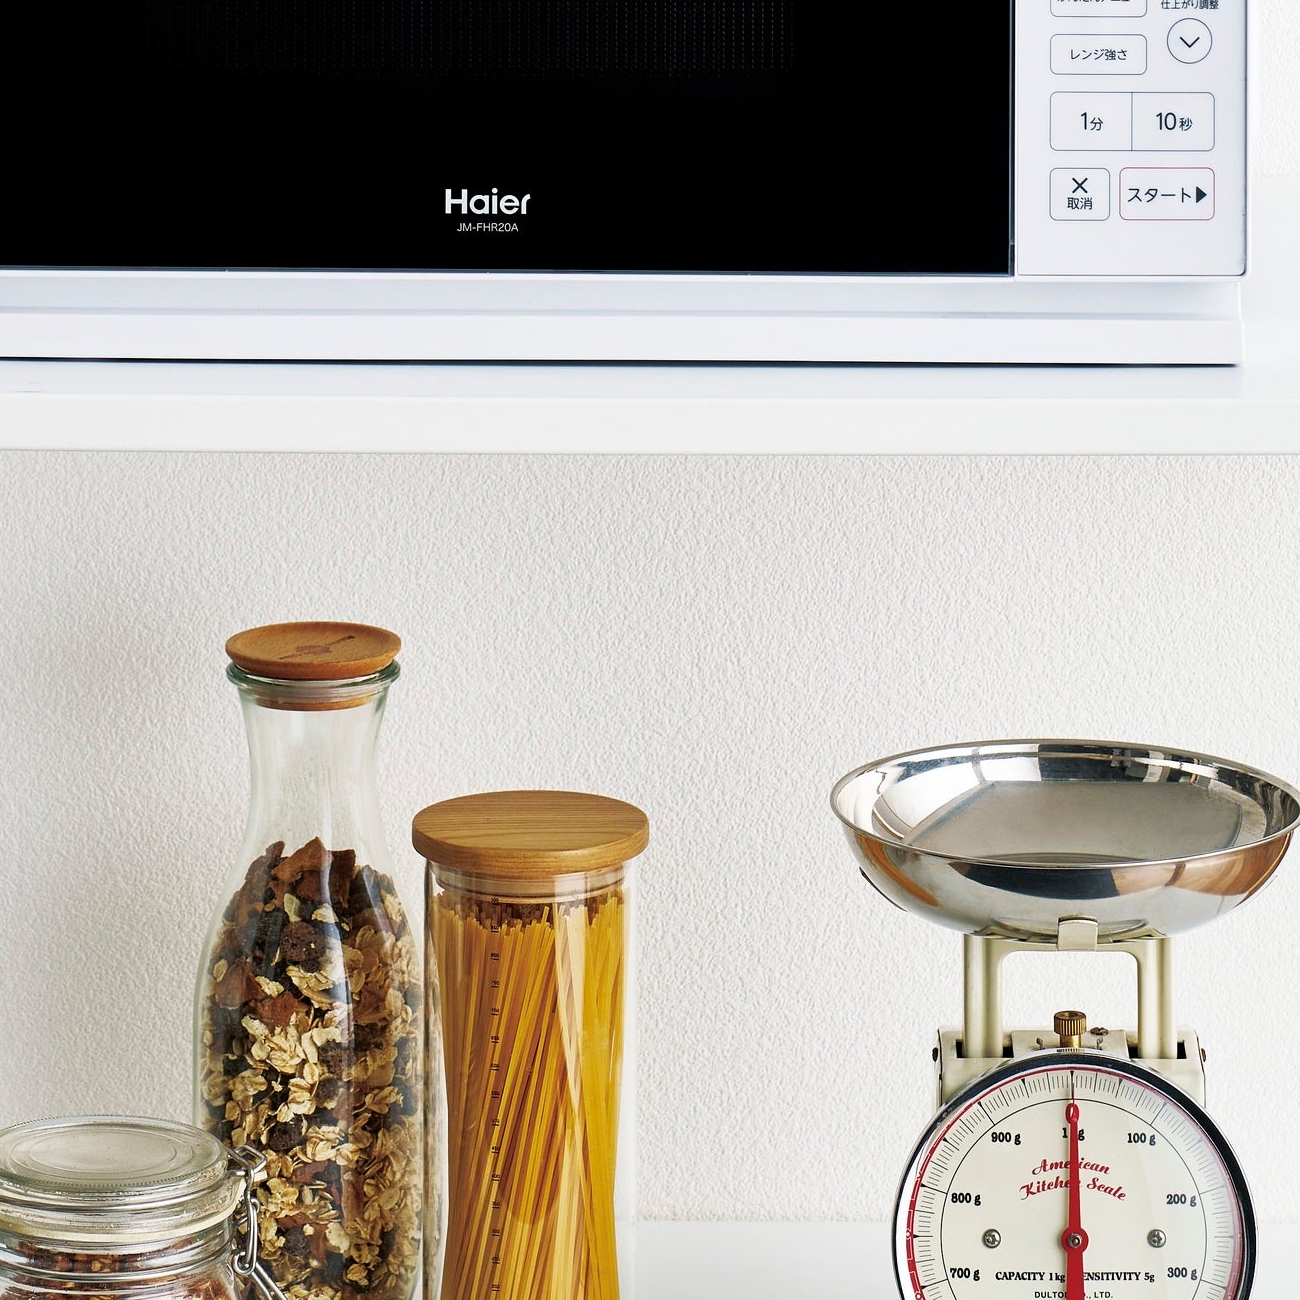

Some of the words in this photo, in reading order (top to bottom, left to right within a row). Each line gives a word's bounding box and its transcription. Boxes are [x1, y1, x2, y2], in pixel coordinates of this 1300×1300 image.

[1160, 0, 1220, 10] 仕上がり調整
[1070, 48, 1128, 61] レンジ強さ
[1080, 111, 1104, 132] 1分
[445, 187, 531, 215] Haier
[1127, 187, 1192, 204] スタート
[1066, 196, 1093, 211] 取消
[456, 222, 519, 232] JM-FHR20A
[991, 1131, 1012, 1143] 900
[1014, 1133, 1021, 1146] g
[1127, 1132, 1146, 1144] 100
[1149, 1134, 1156, 1146] g
[1032, 1157, 1110, 1176] Ameican
[1019, 1175, 1081, 1201] Kitche
[1086, 1177, 1126, 1201] Scale
[951, 1192, 972, 1204] 800
[974, 1193, 981, 1206] g
[1166, 1194, 1186, 1205] 200
[1189, 1195, 1197, 1207] g
[949, 1268, 971, 1279] 700
[973, 1269, 980, 1281] g
[995, 1271, 1045, 1281] CAPACITY
[1083, 1271, 1141, 1281] ENSITIVITY
[1144, 1272, 1155, 1283] 5g
[1167, 1267, 1188, 1278] 300
[1190, 1269, 1198, 1280] g
[1034, 1291, 1066, 1299] DULTO
[1094, 1291, 1113, 1299] LTD.
